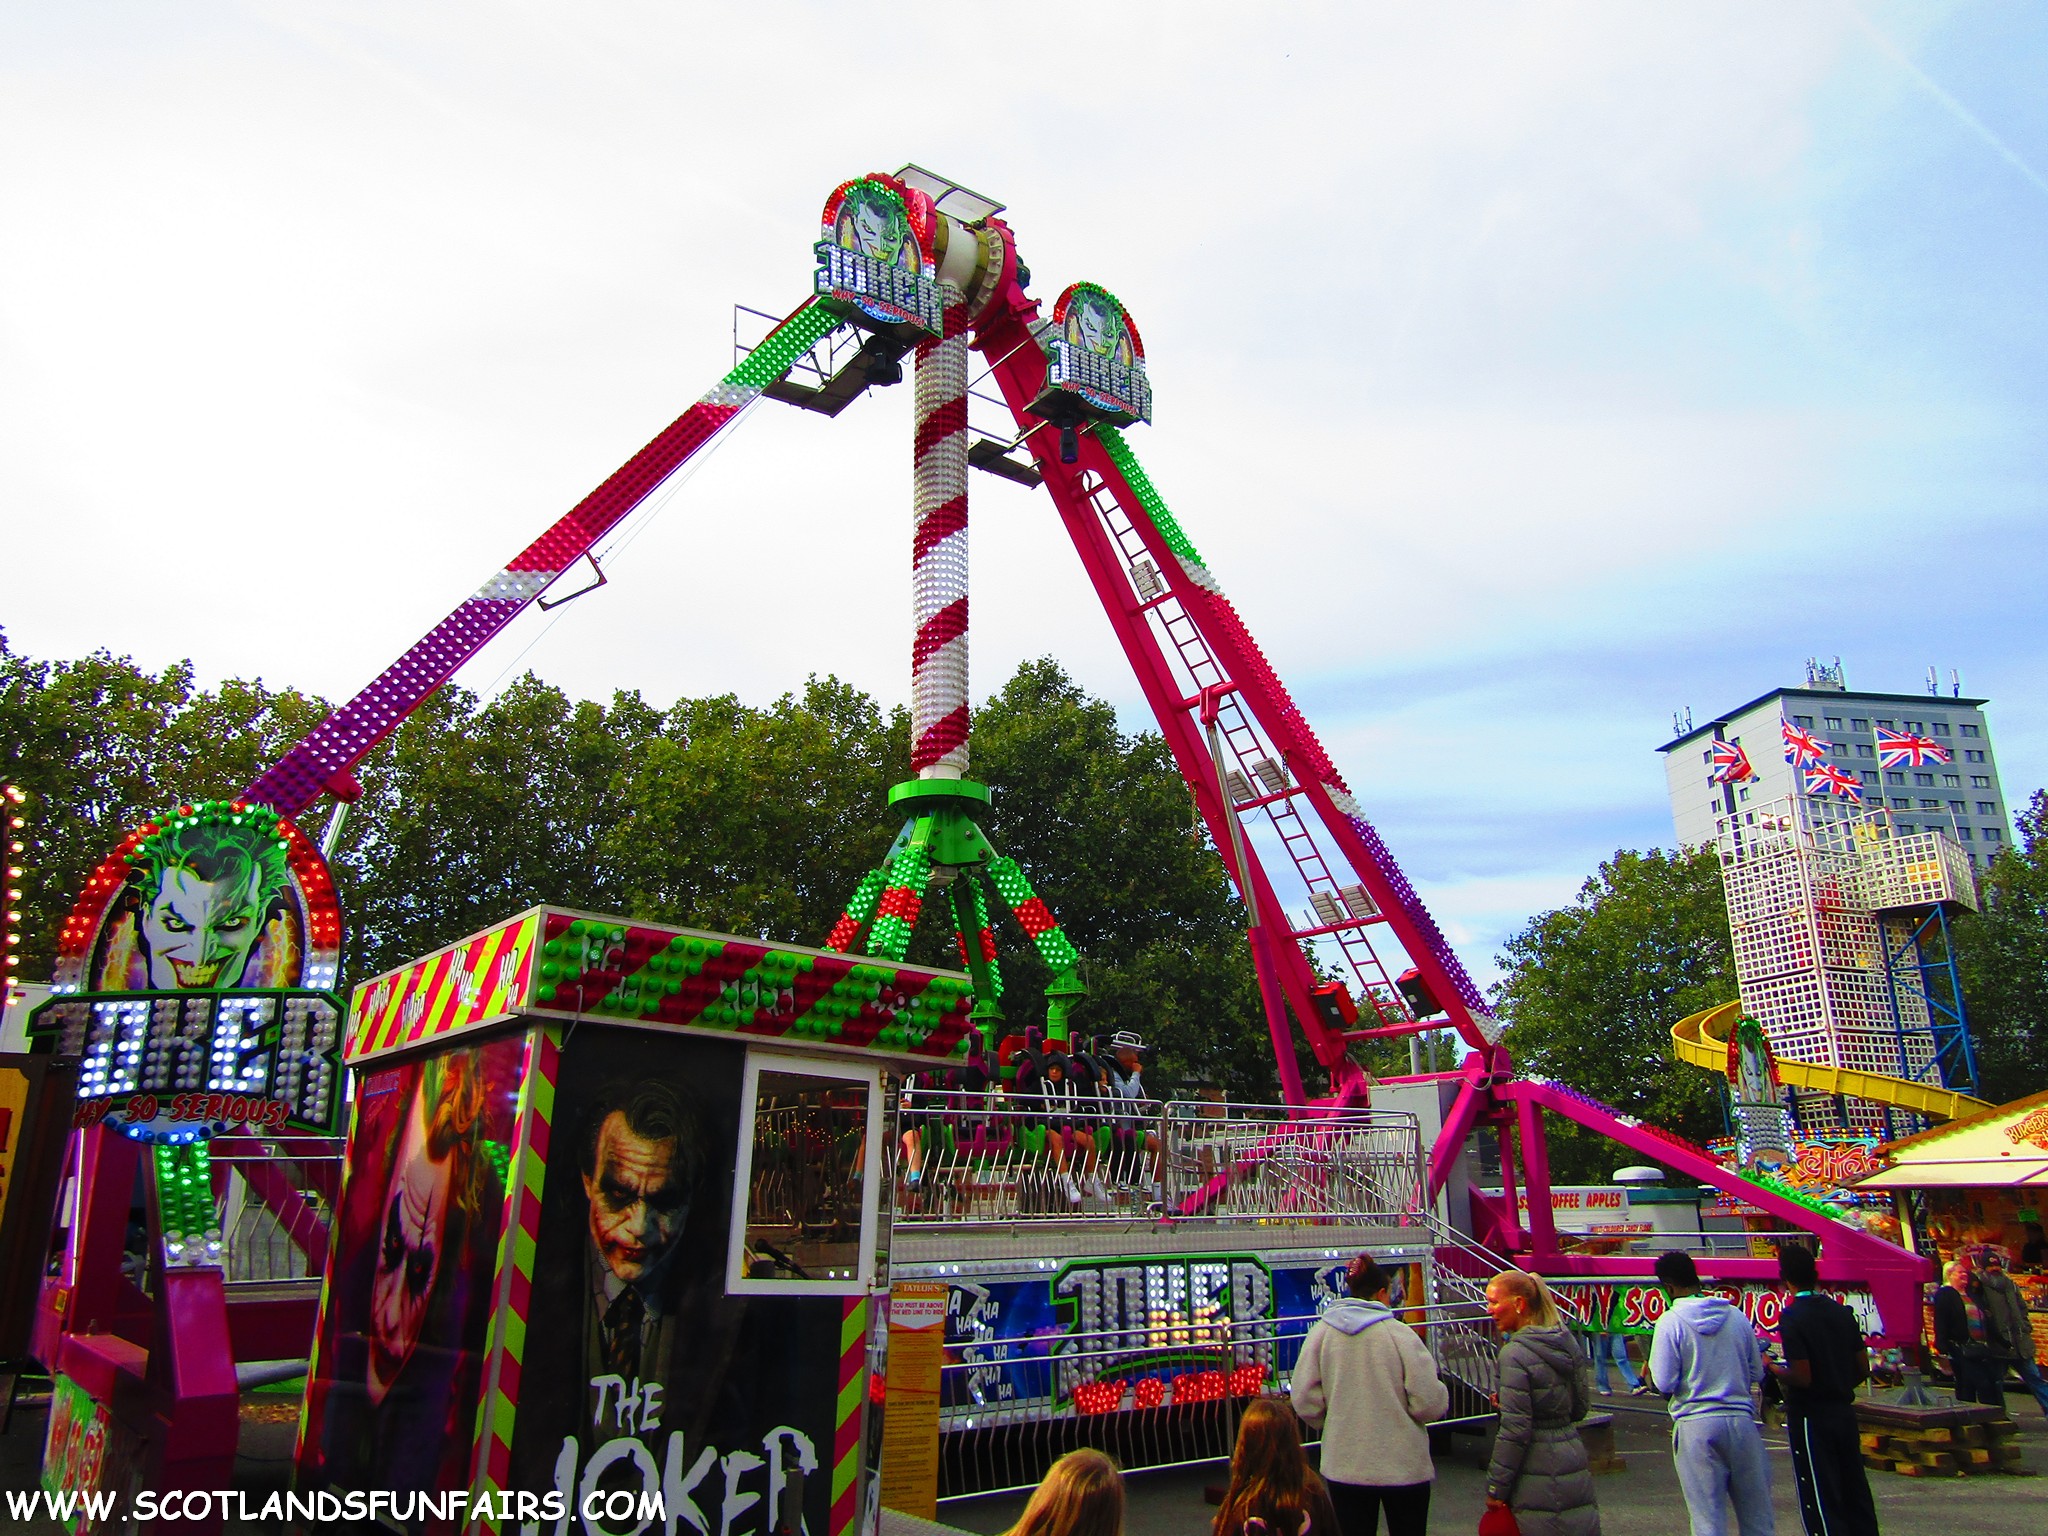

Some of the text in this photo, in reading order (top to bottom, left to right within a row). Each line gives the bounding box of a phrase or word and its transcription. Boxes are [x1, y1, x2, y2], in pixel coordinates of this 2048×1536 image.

[817, 243, 942, 335] JOKER
[832, 290, 856, 304] WHY
[861, 296, 875, 308] SO
[1049, 340, 1150, 418] JOKER
[1061, 381, 1080, 395] WHY
[1085, 386, 1097, 398] SO
[72, 1094, 291, 1131] HY SO SERIOUS!
[1551, 1192, 1580, 1210] OFFEE
[1586, 1191, 1622, 1209] APPLES
[982, 1302, 999, 1321] HA
[1622, 1285, 1666, 1326] SO
[956, 1316, 971, 1335] HA
[1058, 1261, 1273, 1397] JOKER
[590, 1373, 665, 1436] THE
[520, 1425, 819, 1536] JOKER
